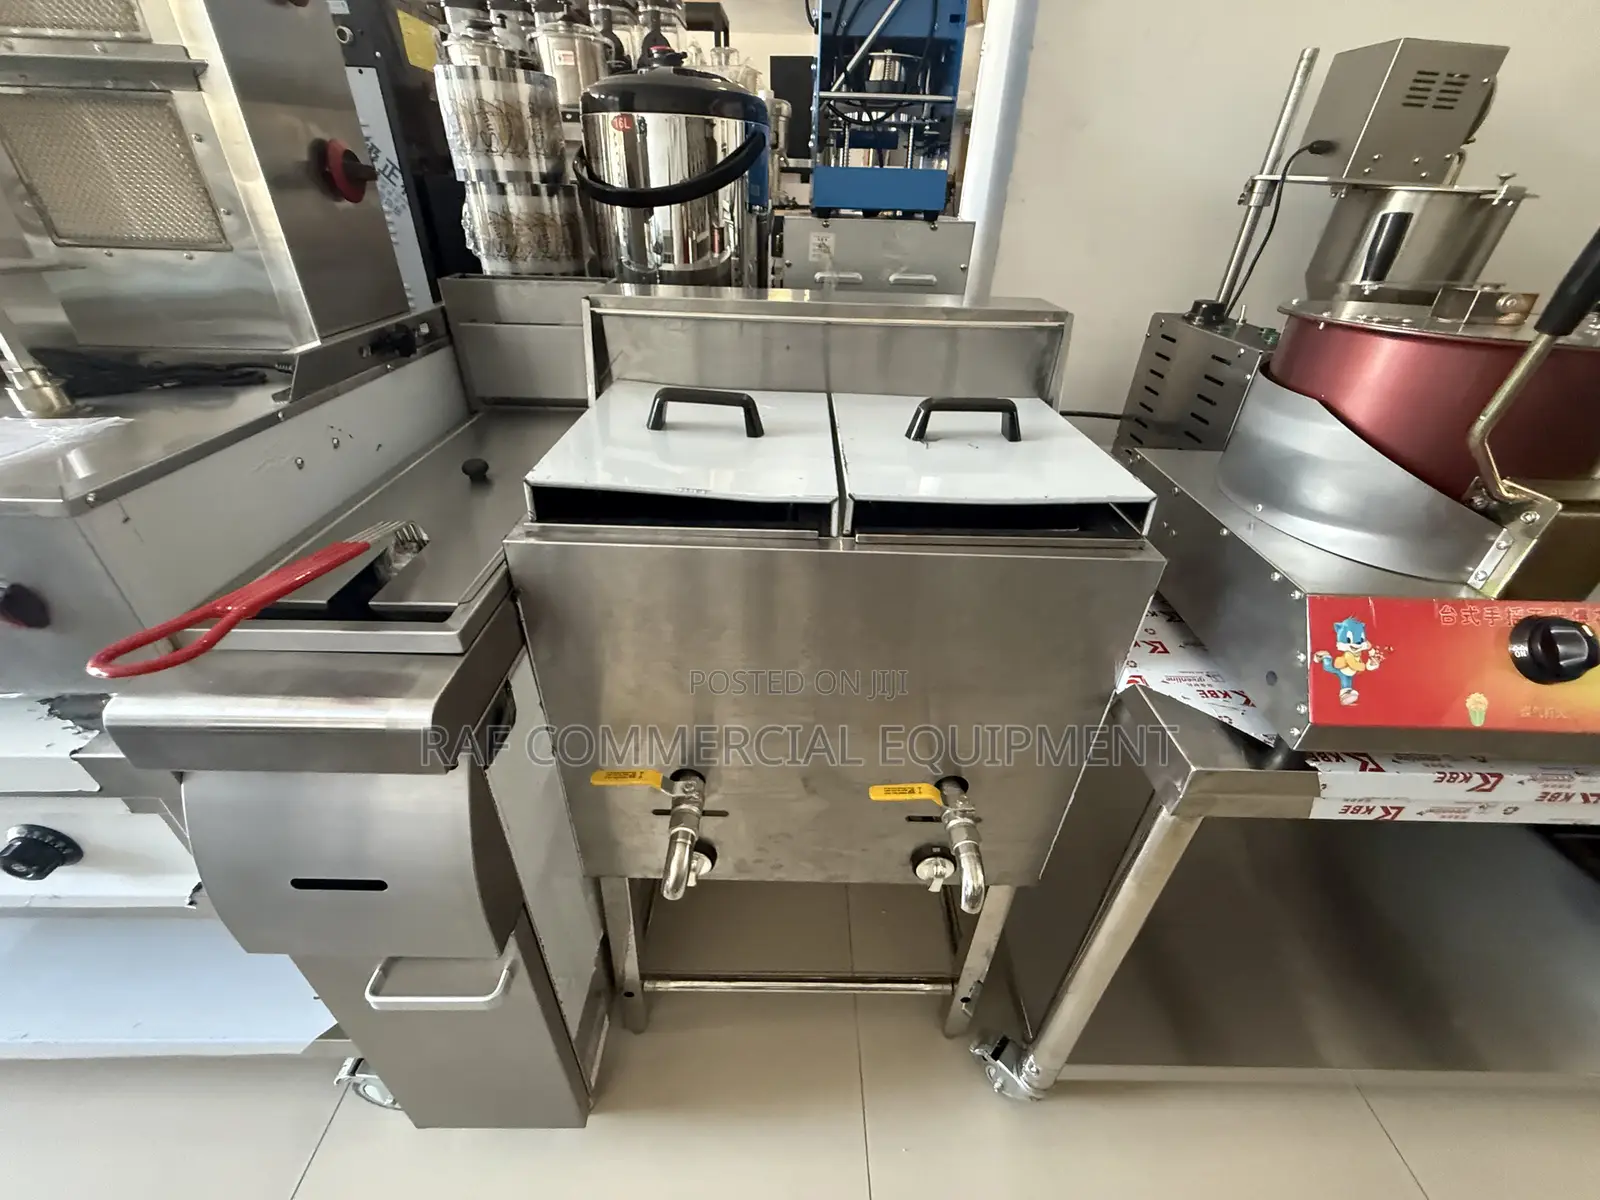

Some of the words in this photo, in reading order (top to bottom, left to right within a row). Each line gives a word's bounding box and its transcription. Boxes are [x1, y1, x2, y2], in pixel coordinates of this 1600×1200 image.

[614, 116, 632, 130] 16L
[1196, 688, 1232, 700] KBE
[1432, 771, 1473, 784] KBE
[1534, 791, 1577, 802] KBE
[1338, 804, 1377, 815] KBE
